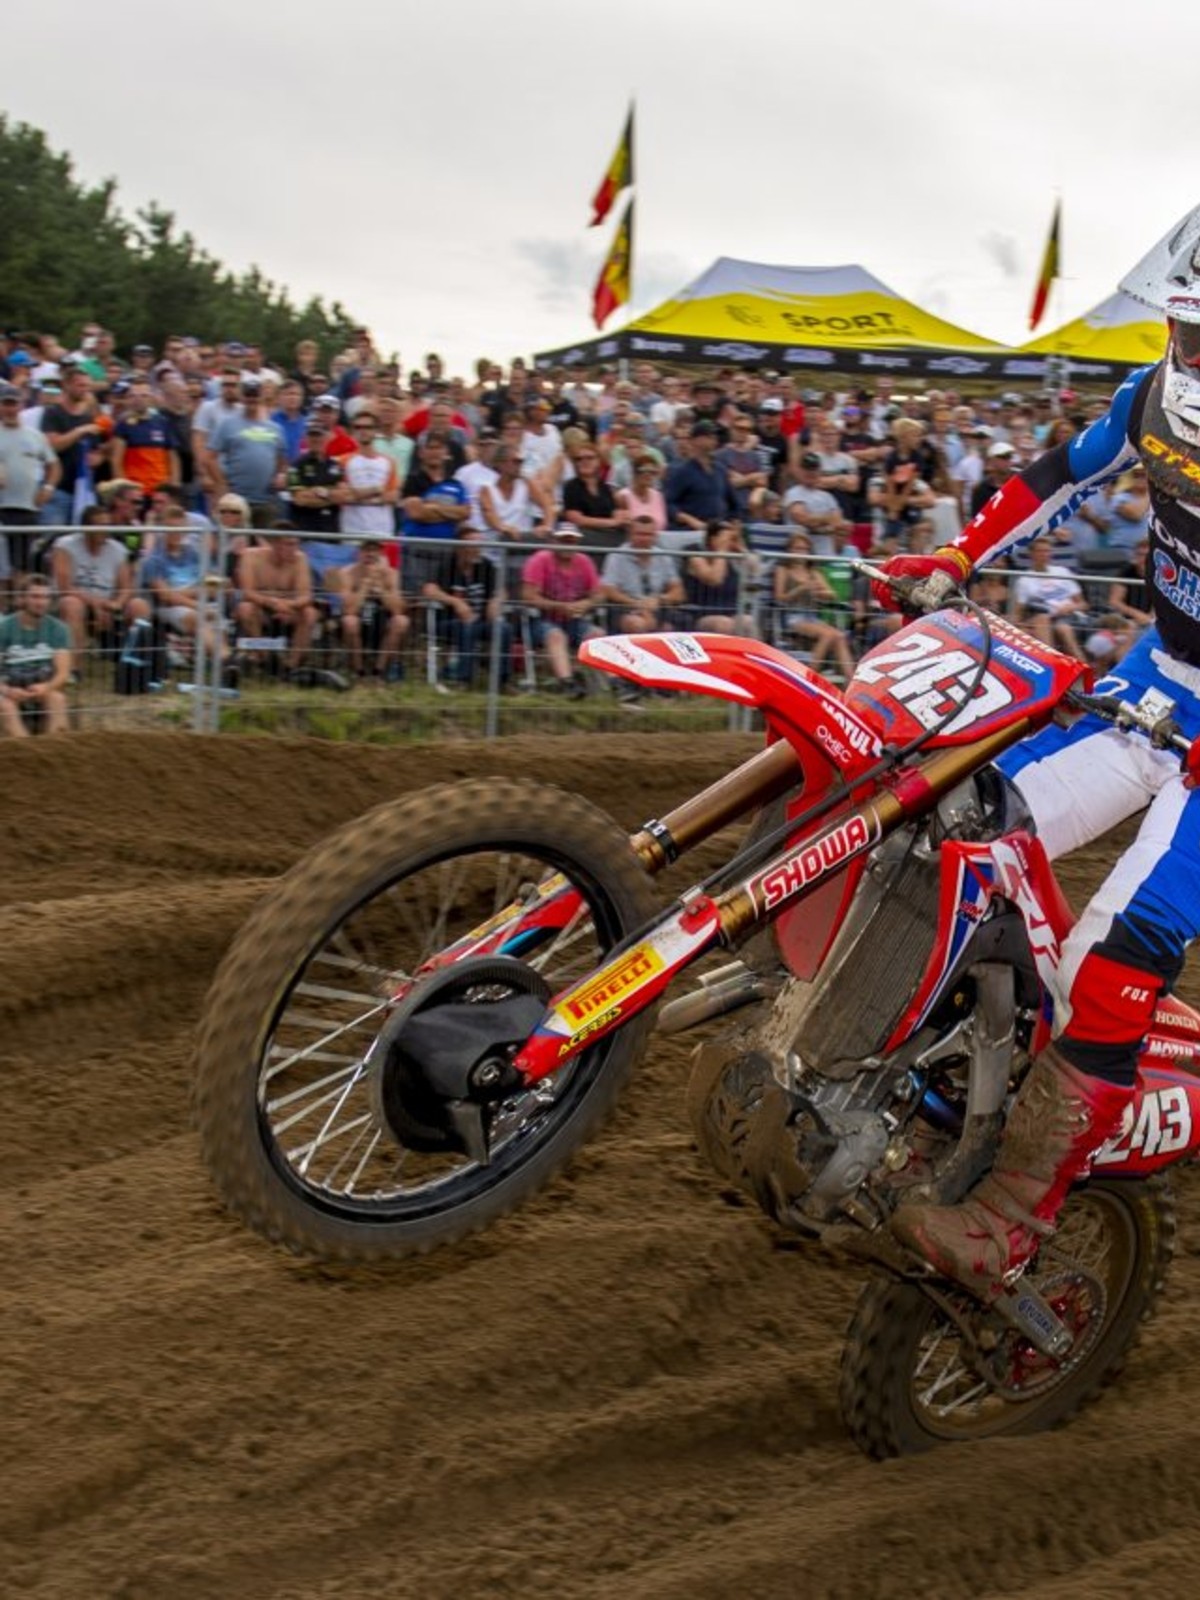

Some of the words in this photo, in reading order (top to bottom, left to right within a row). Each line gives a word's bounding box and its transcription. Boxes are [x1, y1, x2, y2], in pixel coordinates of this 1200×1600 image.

[780, 311, 895, 331] SPORT
[852, 632, 1013, 736] 243
[993, 645, 1045, 675] MXGP
[822, 700, 872, 757] MOTUL
[762, 815, 869, 912] SHOWA
[565, 951, 653, 1021] PIRELLI
[1121, 985, 1149, 1003] FOX
[1154, 1010, 1200, 1033] HONDA
[1094, 1086, 1193, 1159] 243
